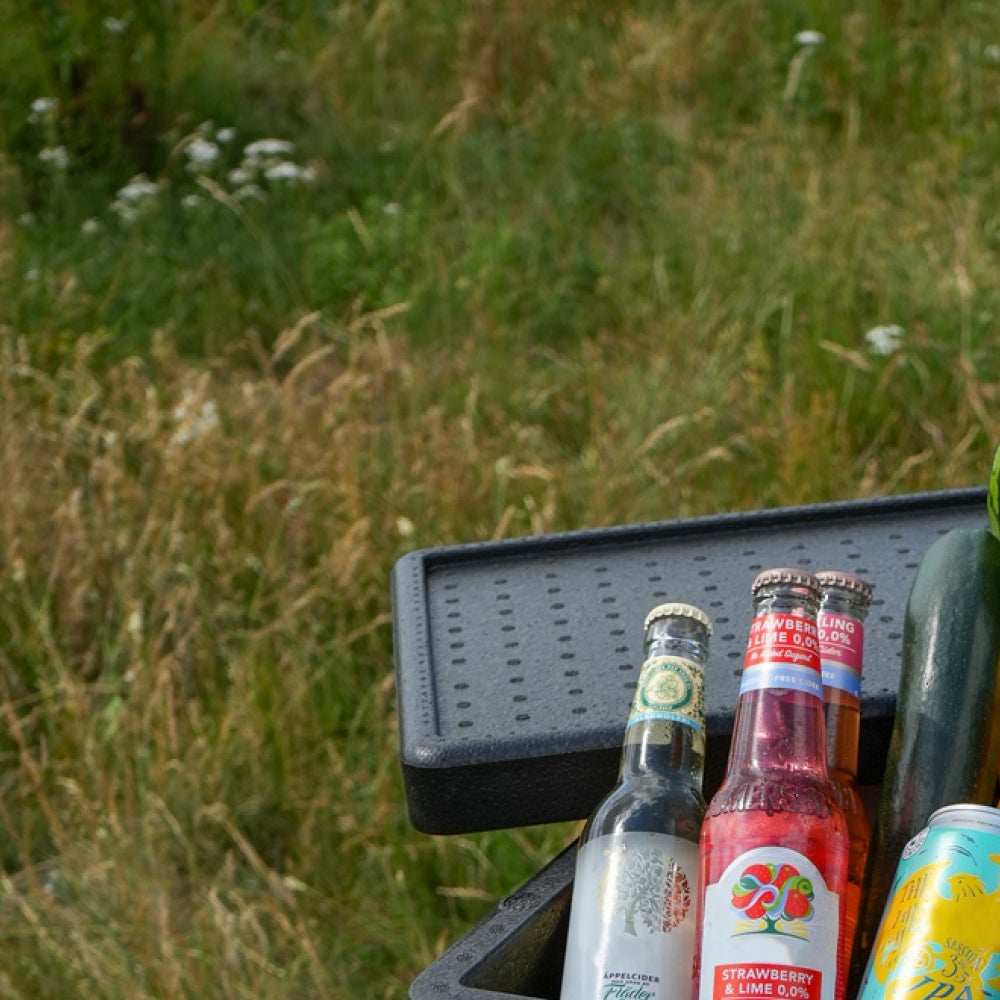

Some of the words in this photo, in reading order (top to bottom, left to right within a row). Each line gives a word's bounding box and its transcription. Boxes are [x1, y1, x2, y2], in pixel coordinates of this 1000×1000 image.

[755, 631, 788, 646] LIME
[721, 967, 814, 986] STRAWBERRY
[724, 983, 734, 996] &
[738, 982, 773, 995] LIME
[777, 984, 810, 1000] 0,0%
